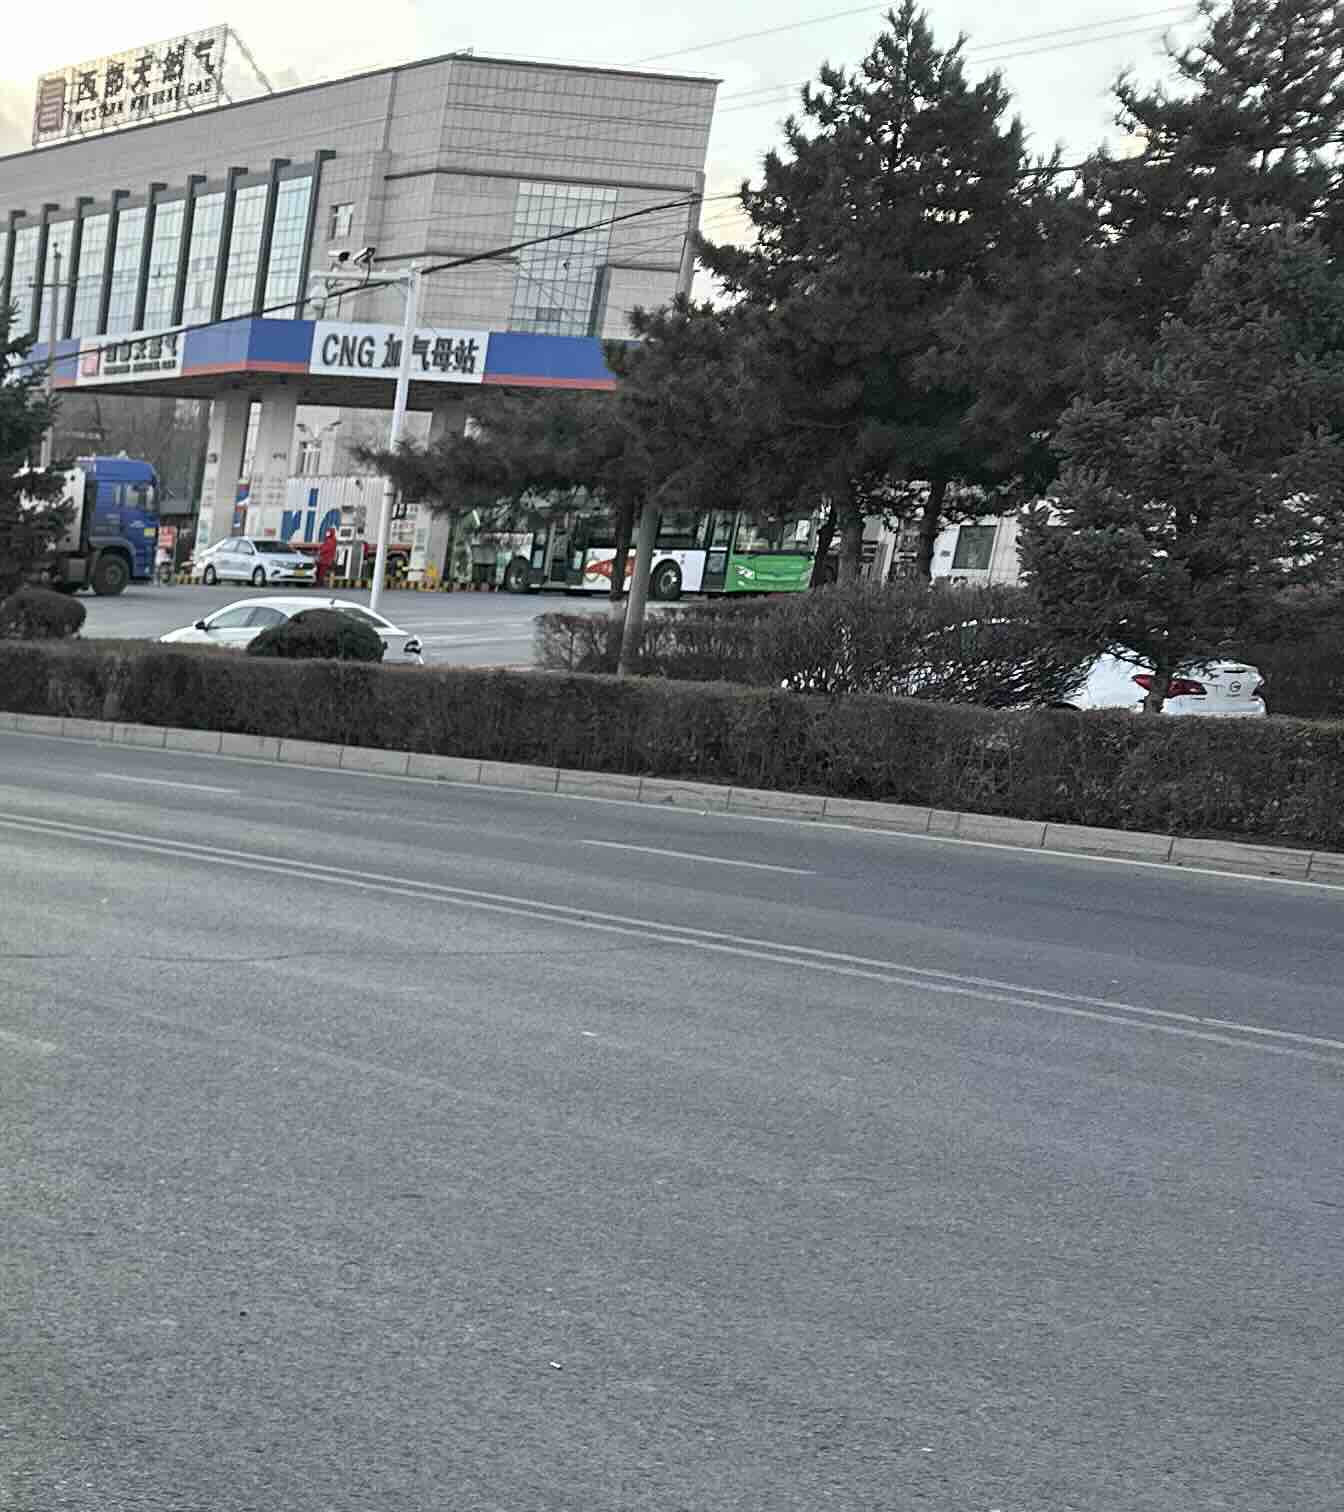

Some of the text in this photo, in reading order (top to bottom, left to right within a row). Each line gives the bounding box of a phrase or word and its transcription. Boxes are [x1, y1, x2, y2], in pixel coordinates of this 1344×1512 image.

[188, 79, 212, 97] GAS
[321, 333, 479, 374] CNG 加气母站
